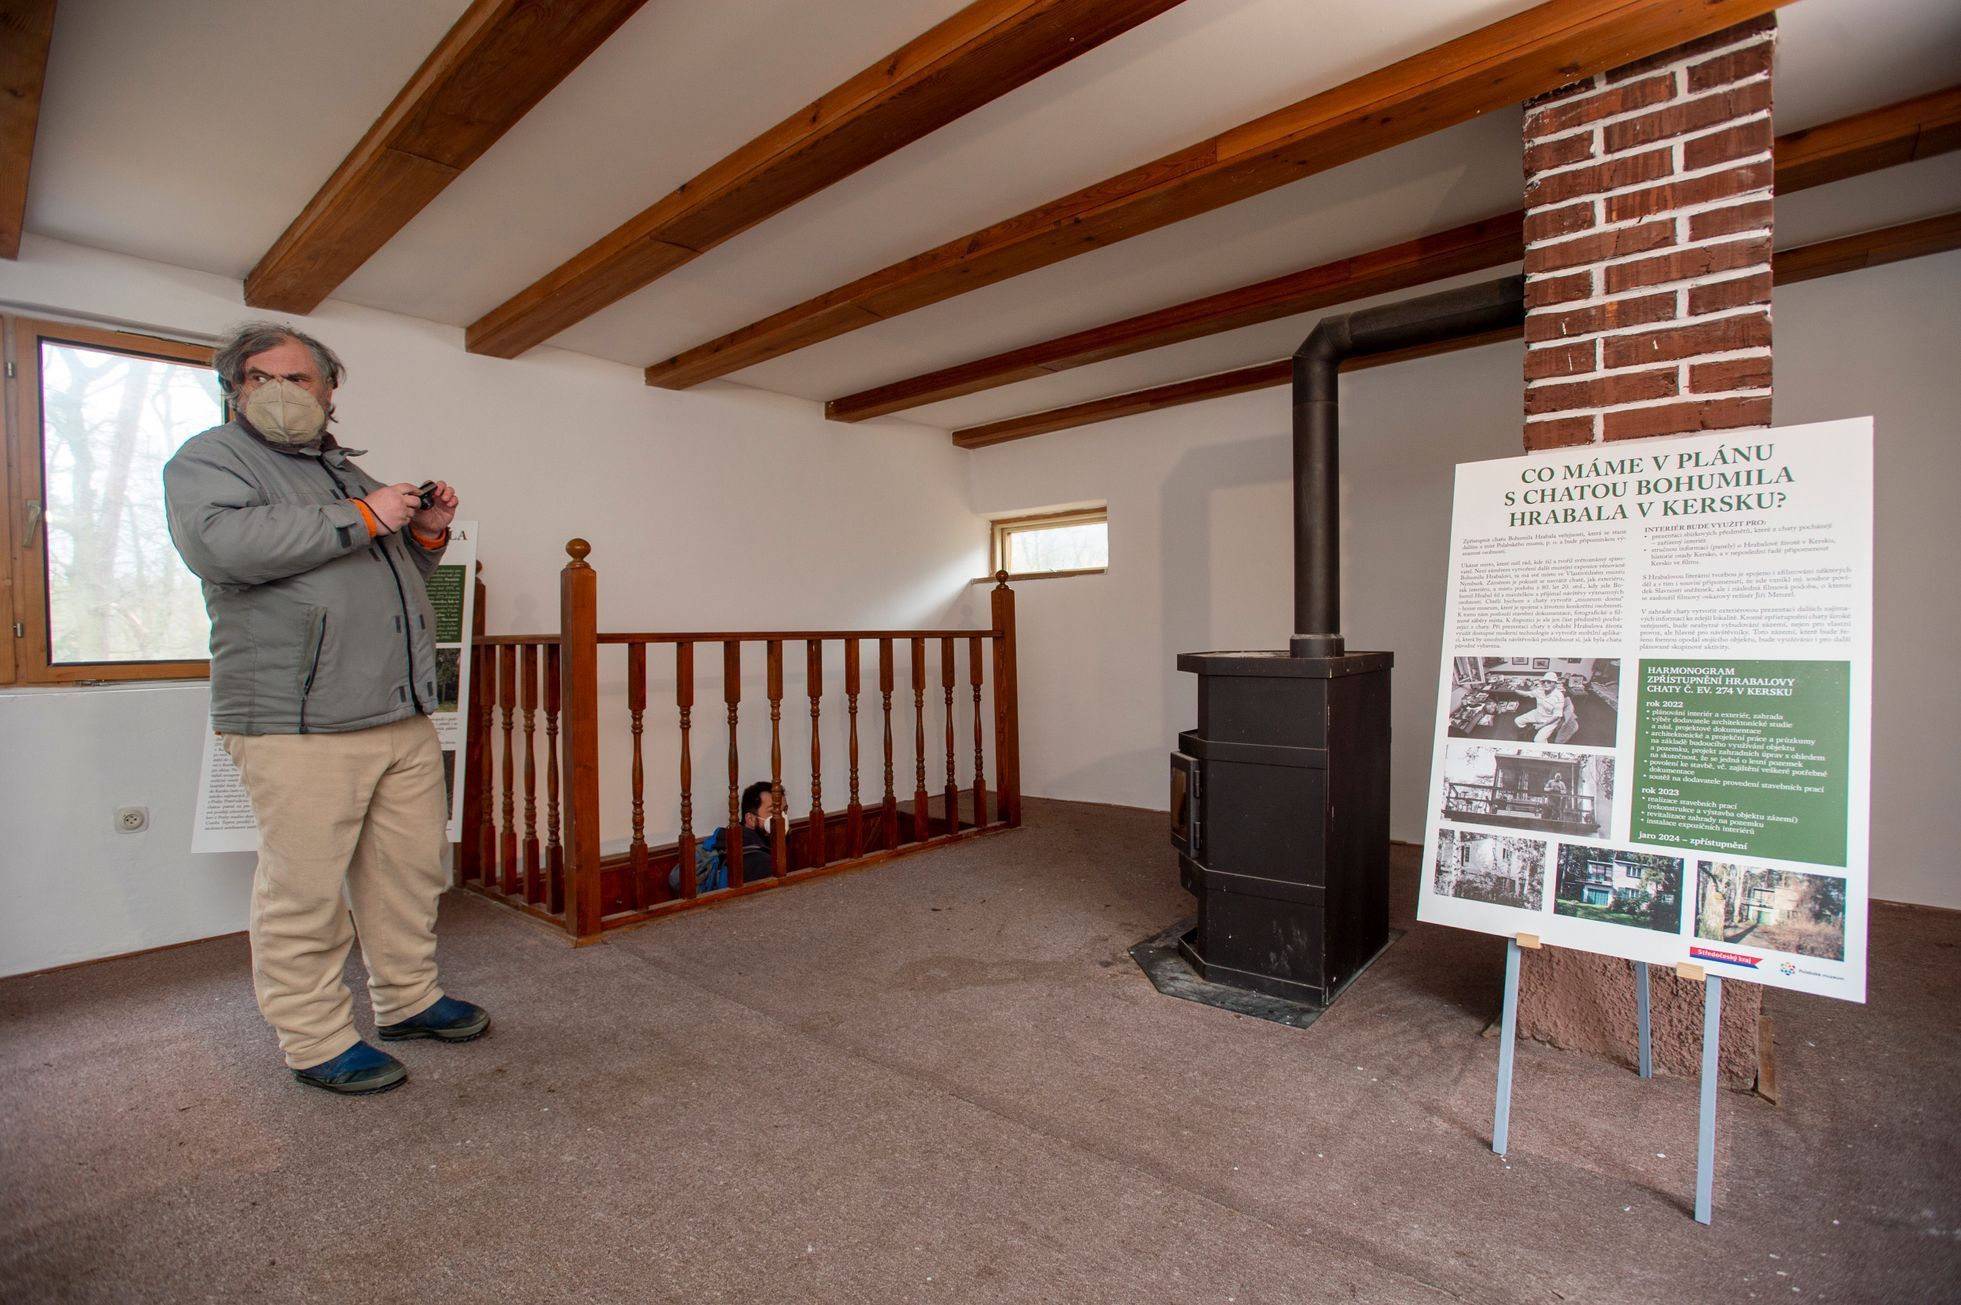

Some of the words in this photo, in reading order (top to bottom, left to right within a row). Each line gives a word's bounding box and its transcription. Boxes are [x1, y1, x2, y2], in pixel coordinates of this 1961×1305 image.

[1521, 466, 1555, 485] CO
[1563, 457, 1645, 480] MÁME
[1652, 454, 1670, 472] V
[1678, 443, 1773, 469] PLÁNU
[1504, 491, 1516, 507] S
[1523, 481, 1627, 506] CHATOU
[1636, 465, 1795, 496] BOHUMILA
[1509, 503, 1629, 528] HRABALA
[1636, 501, 1655, 518] V
[1663, 490, 1786, 516] KERSKU?
[1644, 524, 1685, 533] INTERIÉR
[1711, 521, 1743, 529] VYUŽIT
[1648, 667, 1735, 675] HARMONOGRAM
[1648, 675, 1722, 685] ZPŘÍSTUPNĚNÍ
[1725, 678, 1795, 686] HRABALOVY
[1647, 685, 1681, 693] CHATY
[1684, 685, 1693, 694] Č.
[1716, 687, 1733, 695] 274
[1737, 687, 1744, 695] V
[1747, 688, 1793, 696] KERSKU
[1712, 719, 1768, 727] architektonické
[1713, 726, 1761, 734] dokumentace
[1651, 731, 1703, 739] architektonické
[1776, 737, 1816, 745] průzkumy
[1660, 753, 1698, 761] skutečnost,
[1719, 749, 1760, 757] zahradních
[1761, 751, 1783, 759] úprav
[1791, 753, 1826, 761] ohledem
[1649, 766, 1695, 775] dokumentace
[1690, 762, 1715, 770] stavbě,
[1792, 769, 1827, 777] potřebné
[1682, 776, 1721, 785] dodavatele
[1761, 782, 1802, 791] stavebních
[1658, 788, 1680, 796] 2023
[1680, 799, 1717, 808] stavebních
[1647, 803, 1695, 813] (rekonstrukce
[1703, 809, 1735, 817] výstavba
[1736, 812, 1765, 820] objektu
[1767, 814, 1799, 824] zázemí)
[1647, 812, 1686, 820] revitalizace
[1688, 815, 1716, 824] zahrady
[1646, 818, 1677, 827] instalace
[1678, 822, 1721, 831] expozičních
[1722, 825, 1755, 834] interiérů
[1638, 831, 1657, 840] jaro
[1659, 833, 1680, 842] 2024
[1690, 838, 1747, 850] zpřístupnění
[1698, 948, 1738, 962] Středočeský
[1739, 955, 1751, 964] kraj
